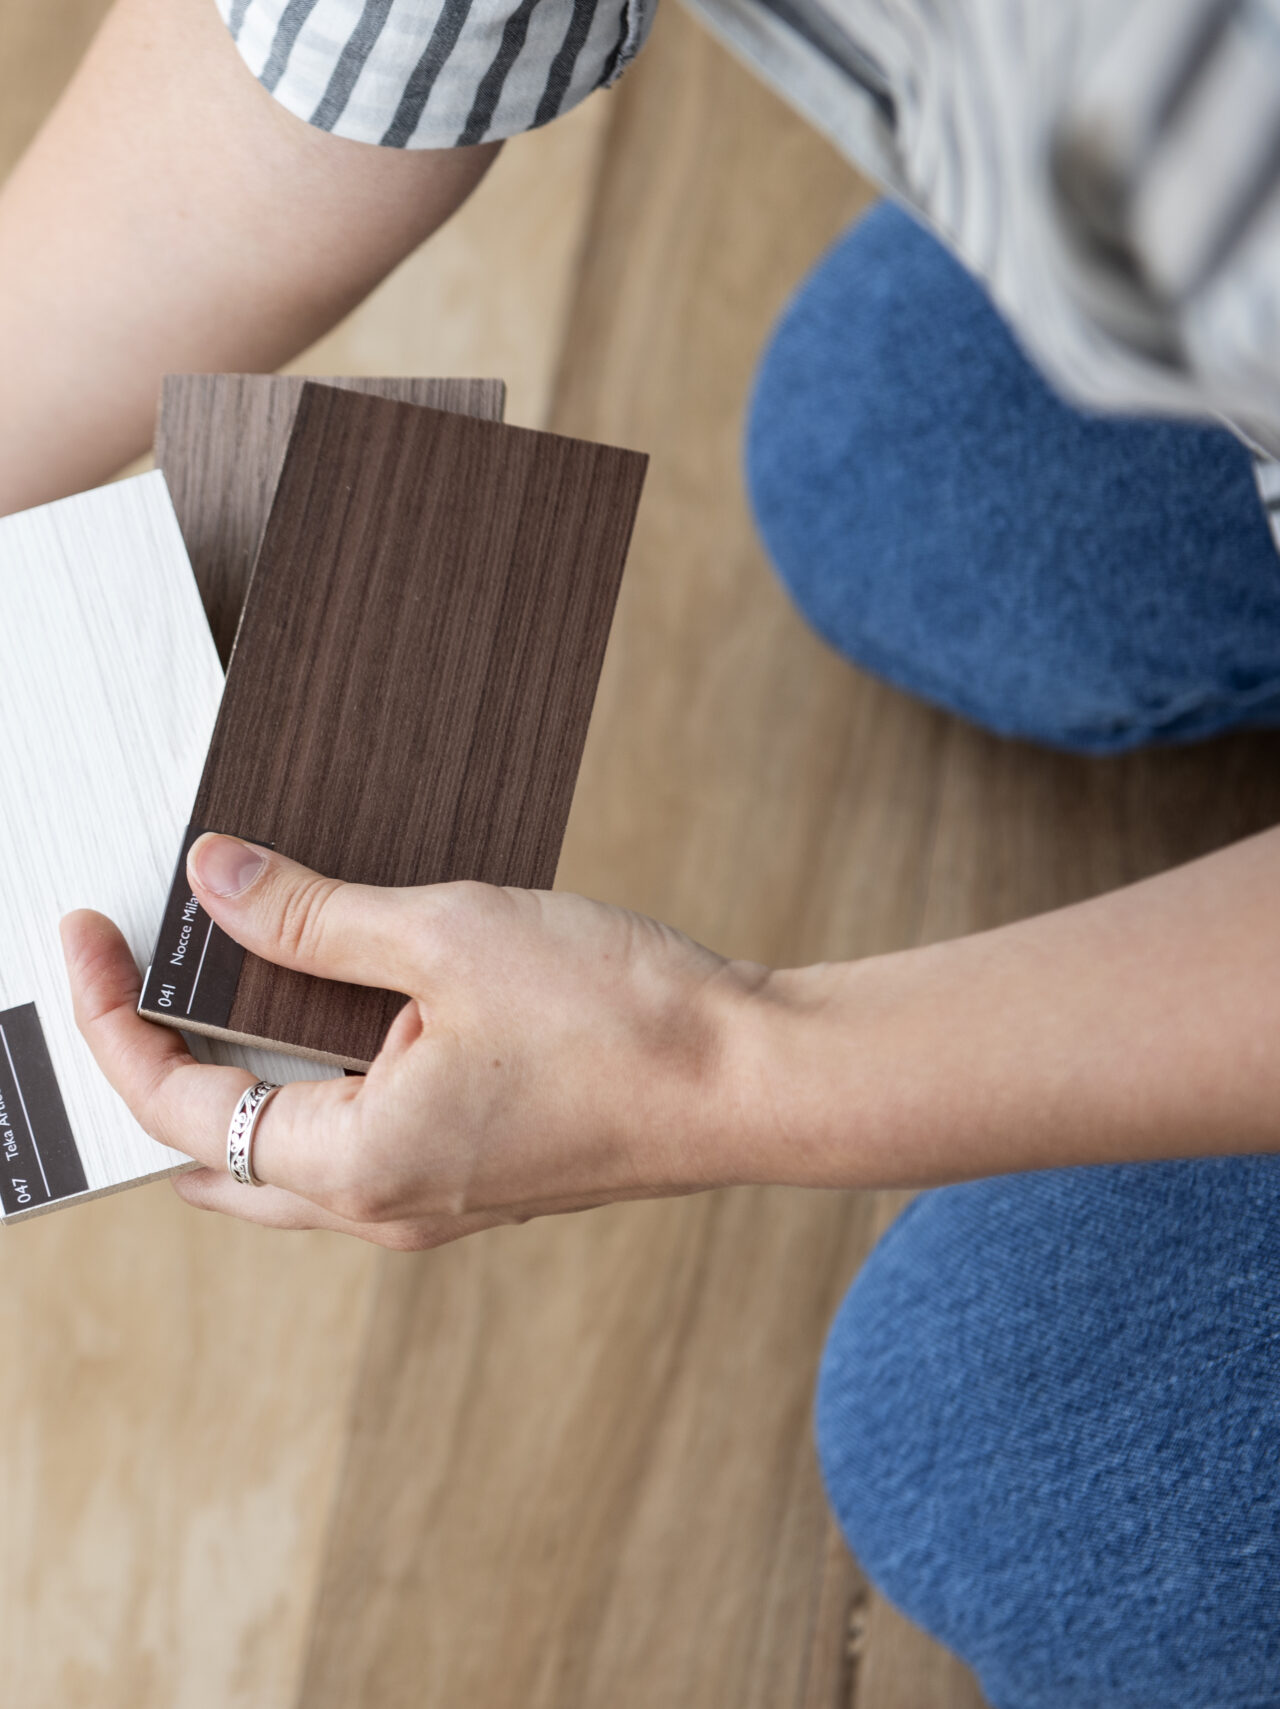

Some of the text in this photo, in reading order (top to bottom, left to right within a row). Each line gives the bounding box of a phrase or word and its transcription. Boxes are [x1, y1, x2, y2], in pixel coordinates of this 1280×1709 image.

[157, 893, 199, 1008] 041 Nocce Mila
[2, 1129, 19, 1162] Teka
[11, 1178, 32, 1204] 047
